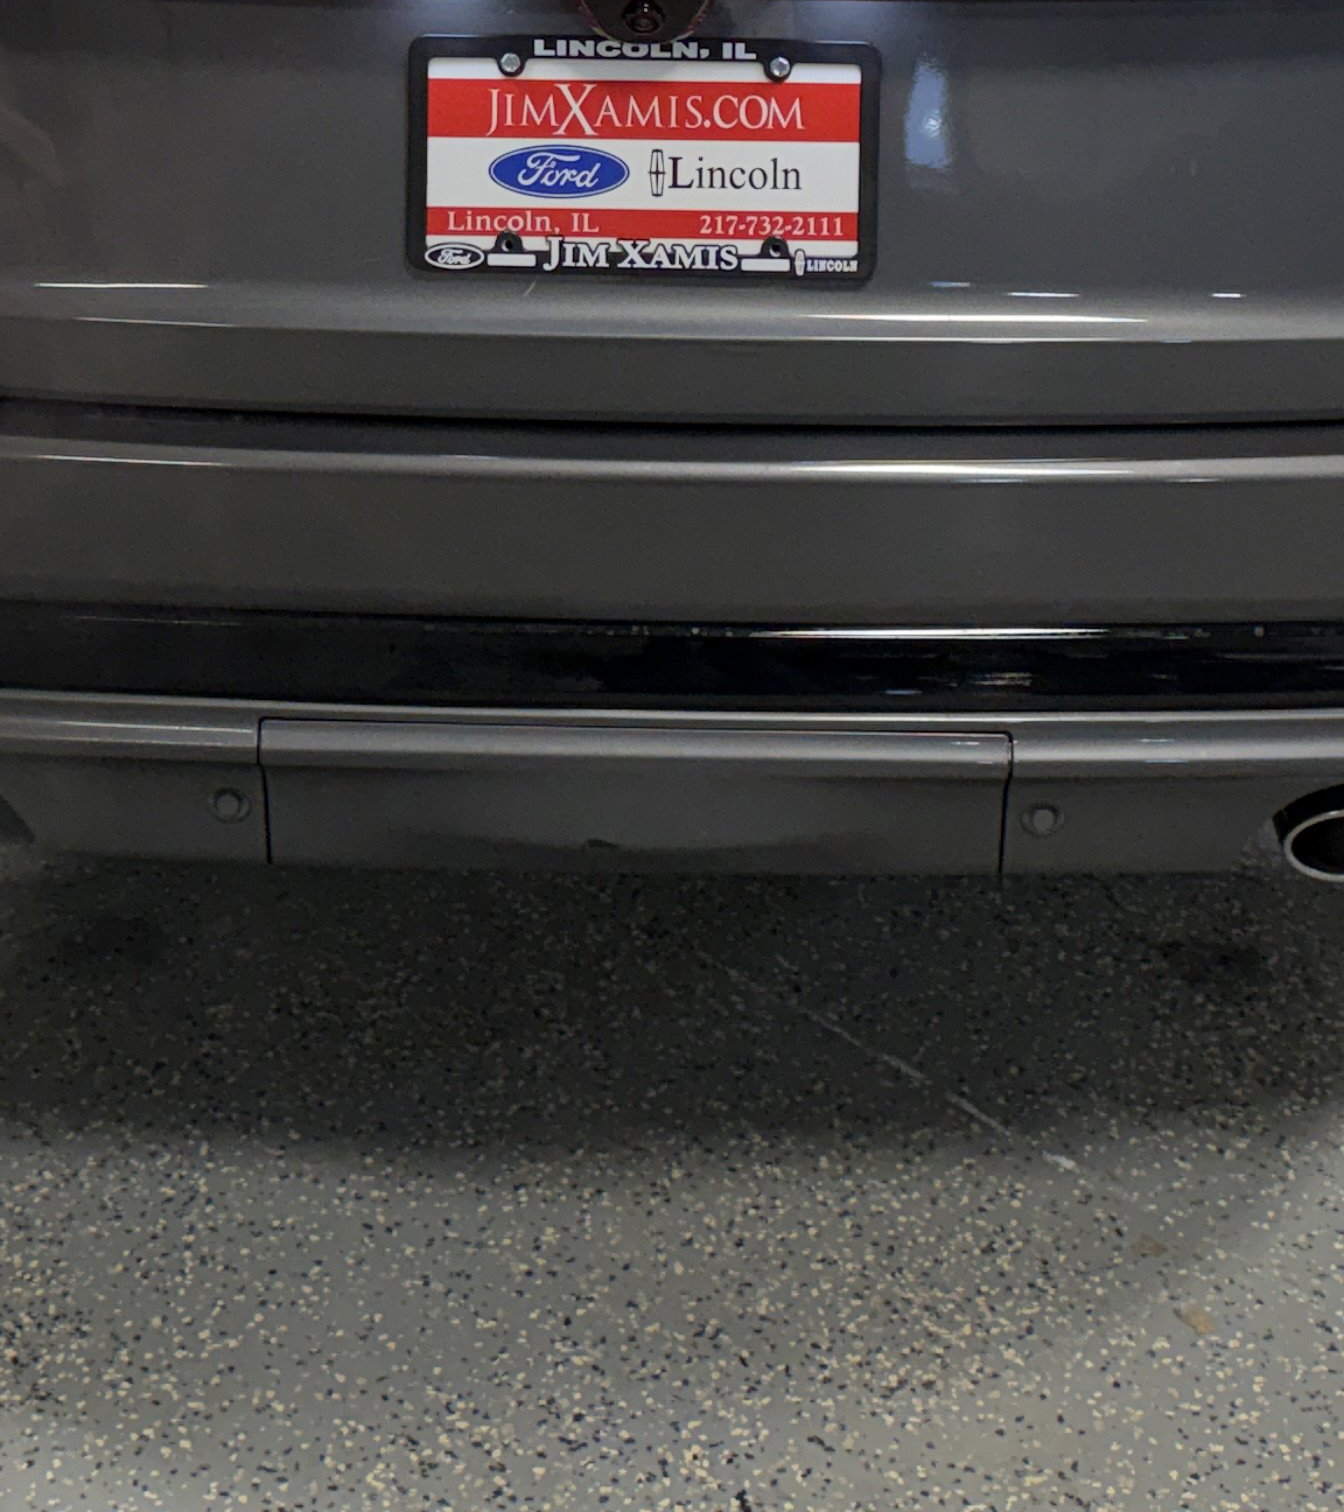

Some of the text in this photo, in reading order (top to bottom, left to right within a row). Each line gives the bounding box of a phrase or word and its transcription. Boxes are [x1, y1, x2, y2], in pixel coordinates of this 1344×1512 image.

[533, 38, 757, 60] LINCOLN, IL
[518, 152, 600, 188] Ford
[668, 157, 803, 191] Lincoln
[571, 214, 599, 233] IL
[699, 215, 843, 237] 217-732-2111
[543, 236, 739, 272] JIM XAMIS
[805, 259, 859, 273] LINCOLN
